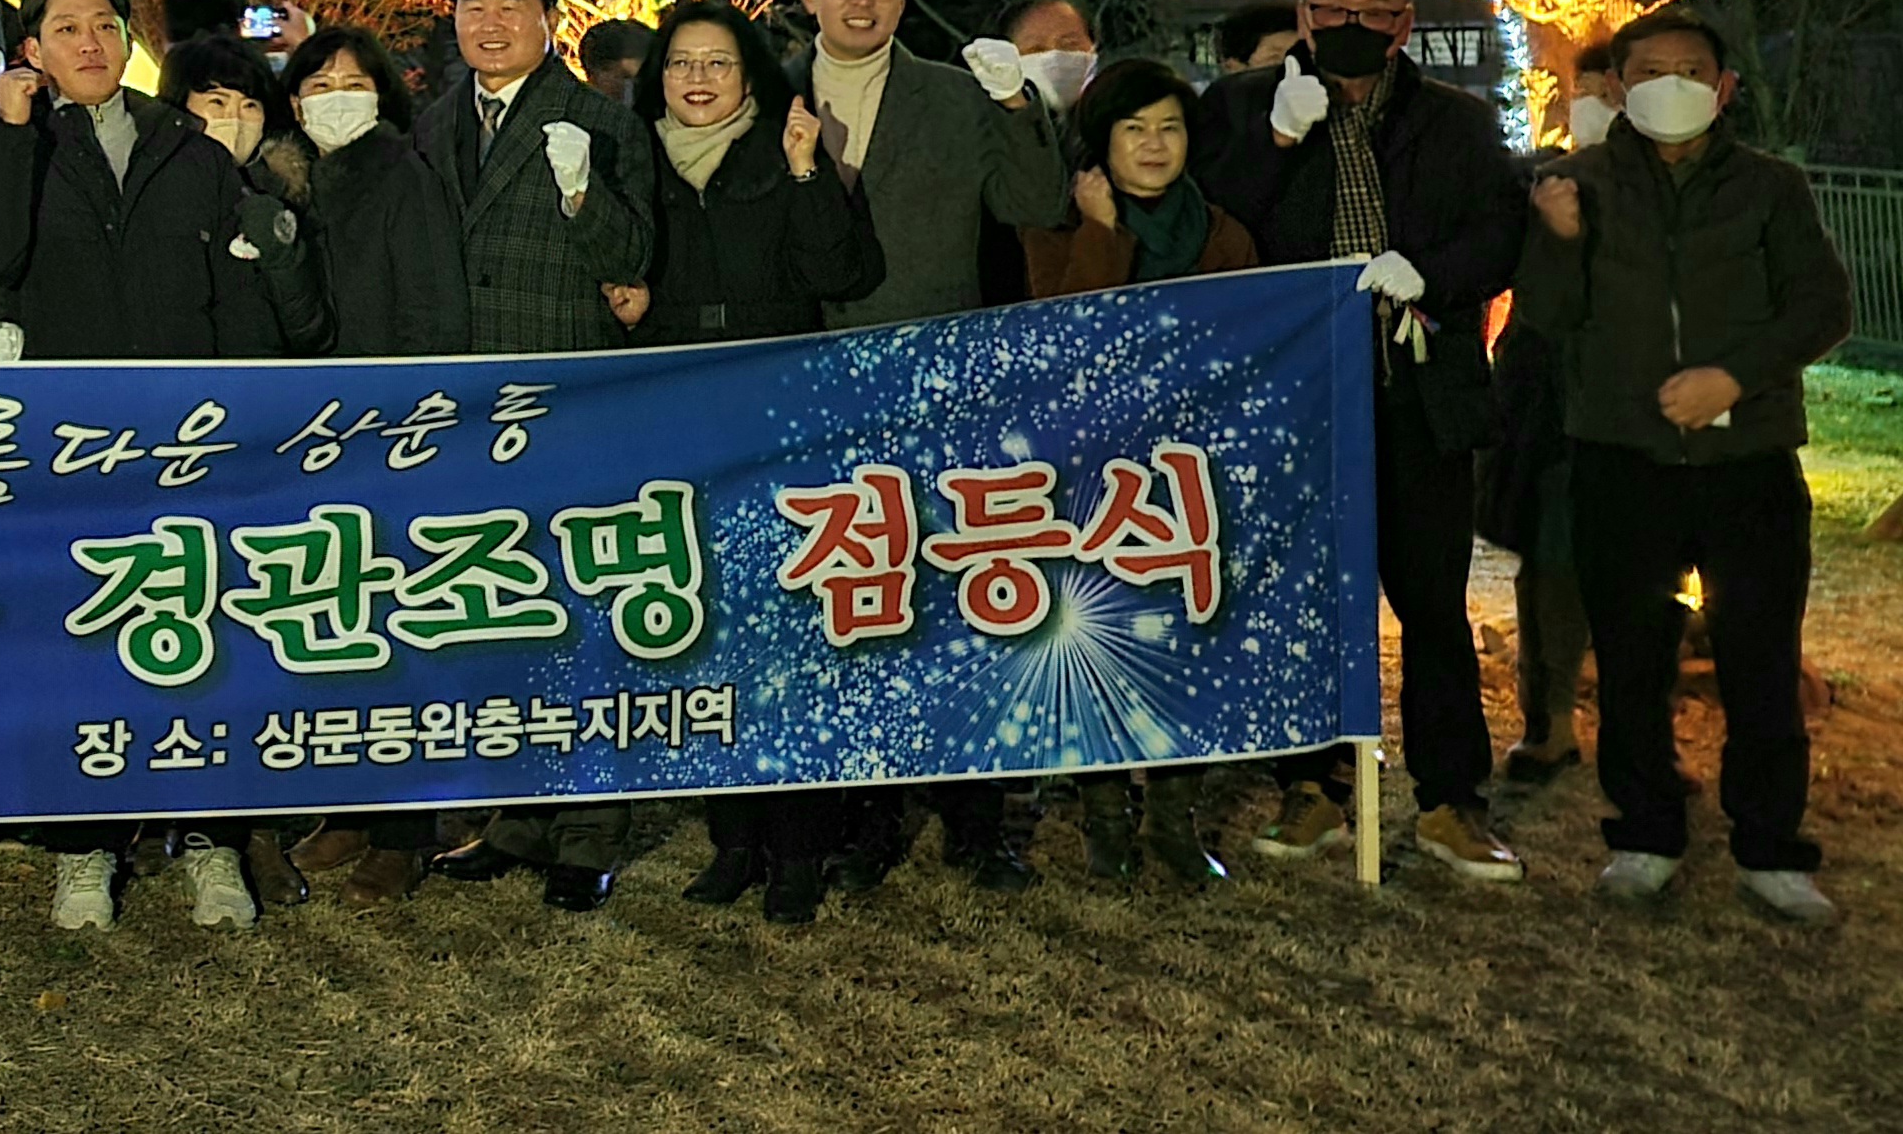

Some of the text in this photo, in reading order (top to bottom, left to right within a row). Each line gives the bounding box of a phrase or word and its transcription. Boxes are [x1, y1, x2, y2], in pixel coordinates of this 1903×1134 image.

[64, 478, 705, 688] 경관조명
[776, 441, 1221, 647] 점등식
[252, 684, 737, 771] 상문동완충녹지지역
